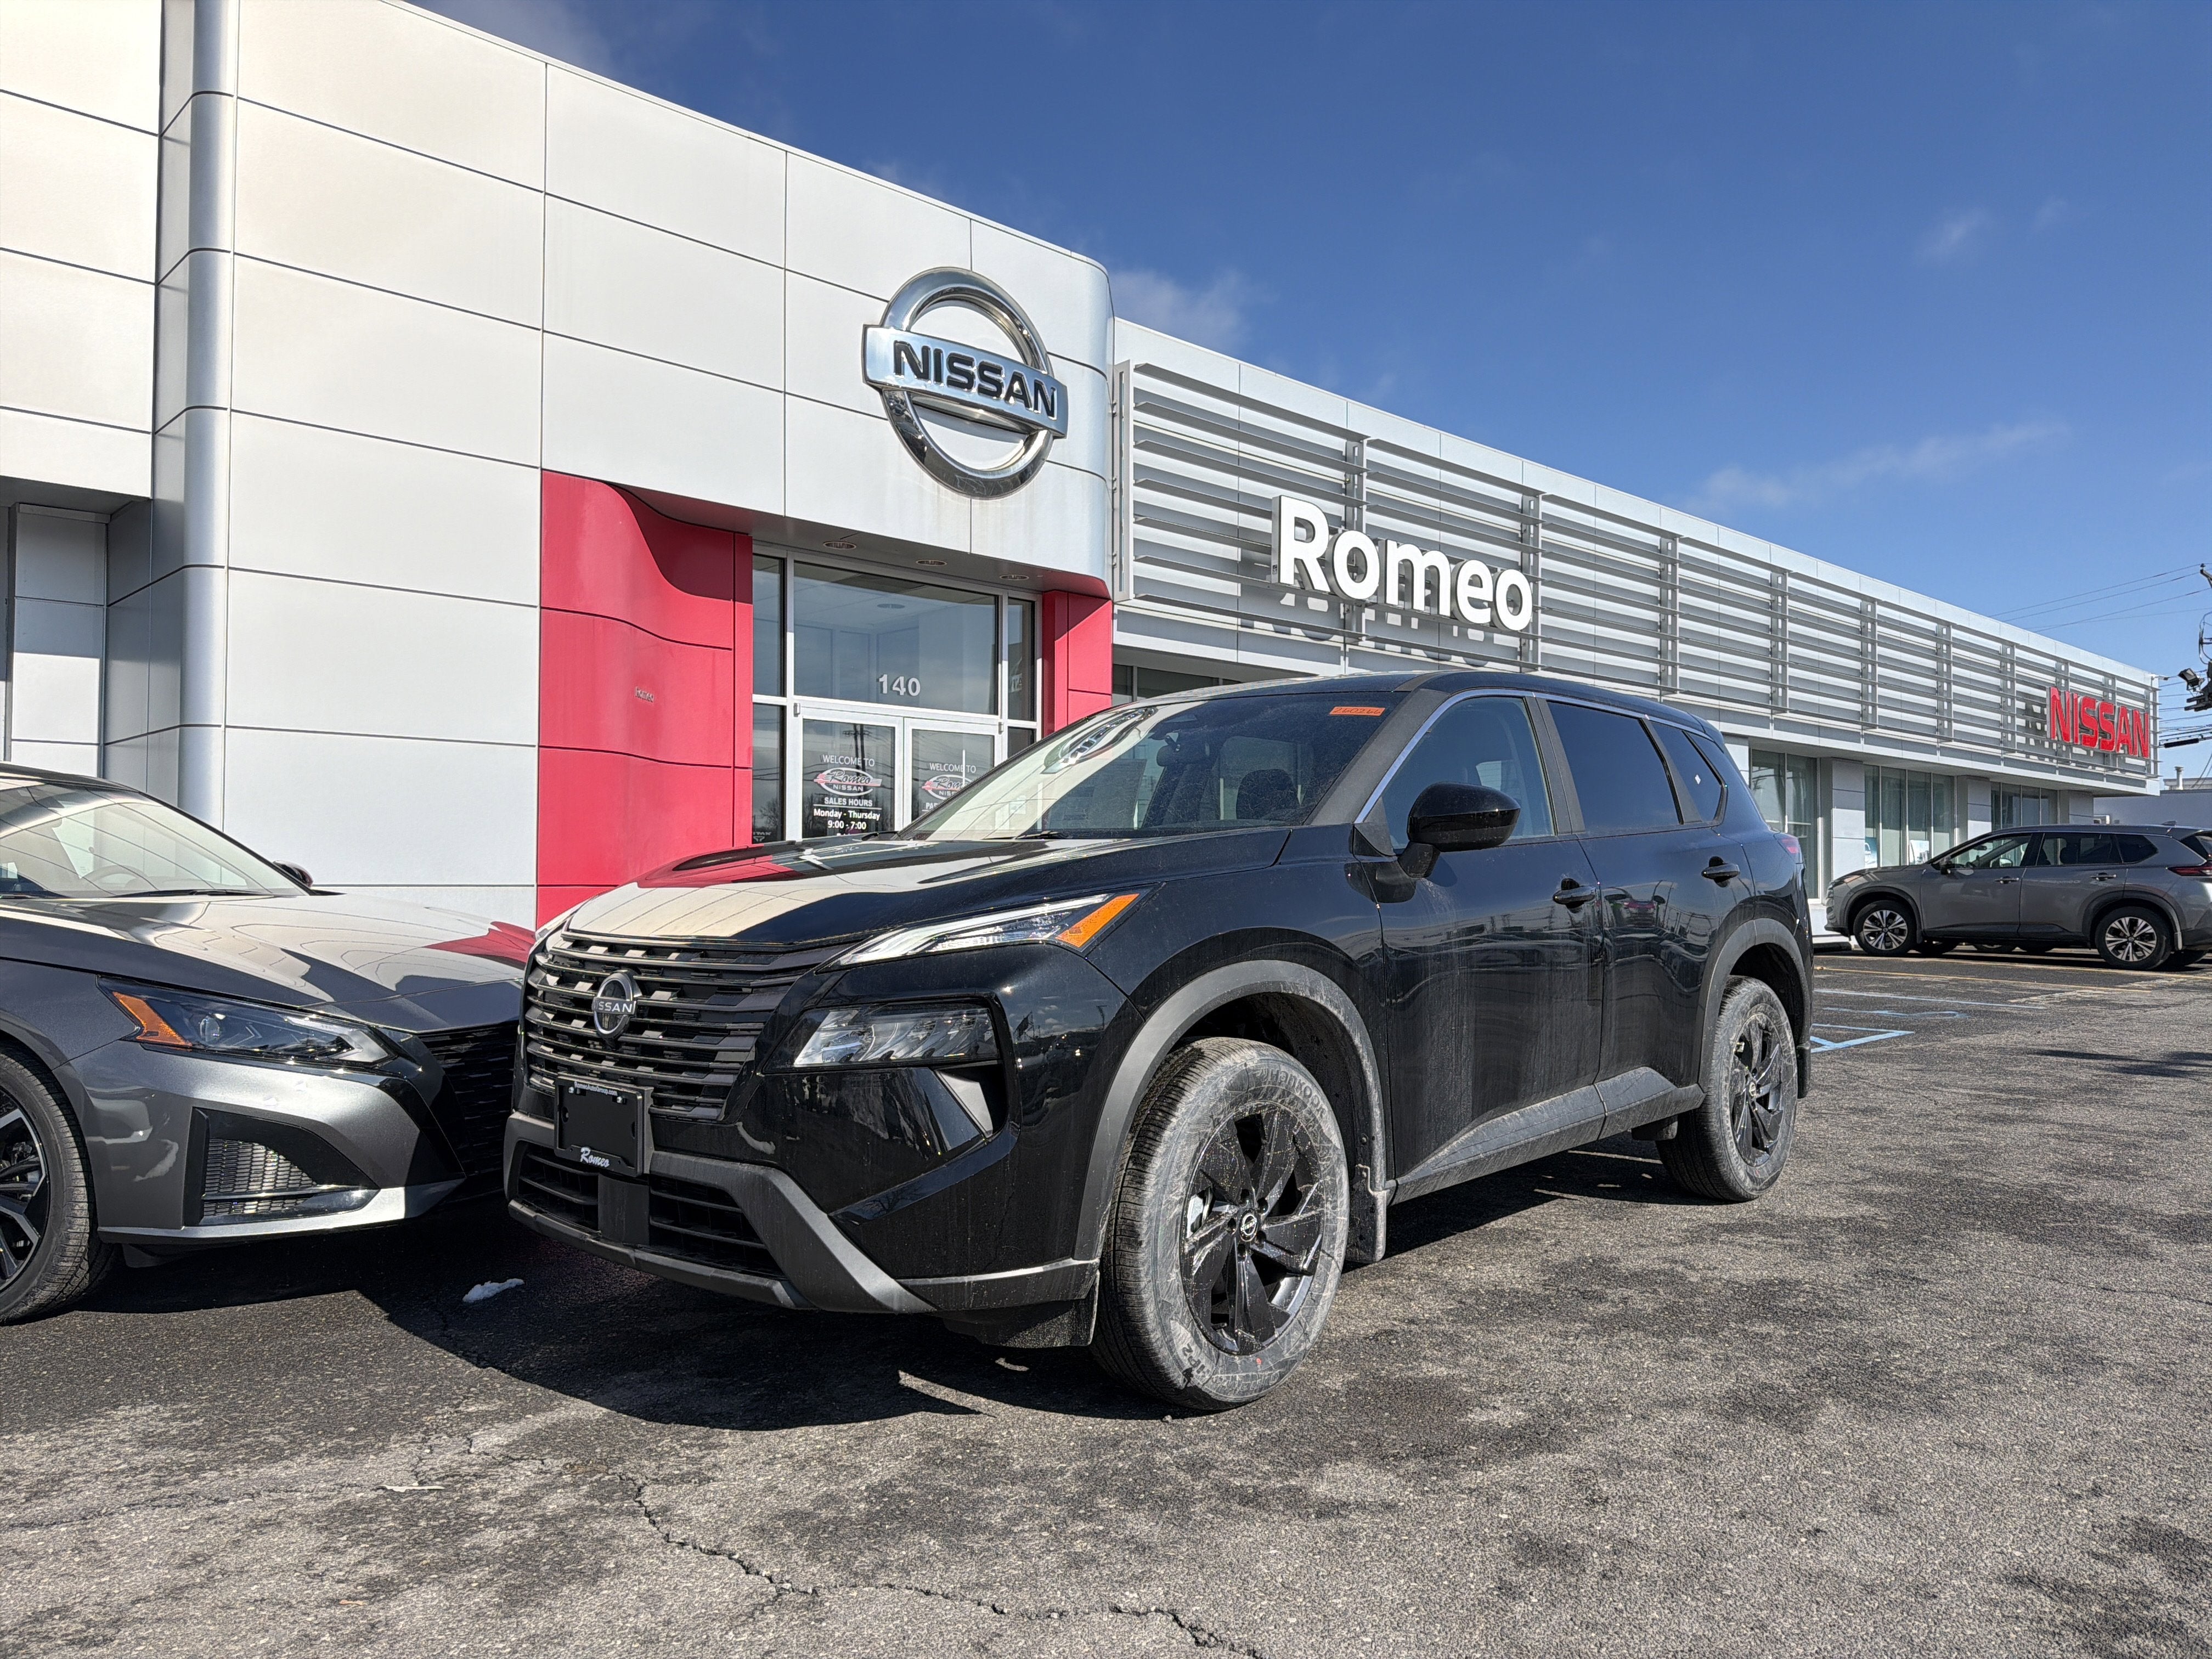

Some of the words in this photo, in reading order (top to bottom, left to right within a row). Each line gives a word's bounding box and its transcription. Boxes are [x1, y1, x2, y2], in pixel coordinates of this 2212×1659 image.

[893, 340, 1057, 421] NISSAN
[1272, 495, 1532, 631] Romeo
[878, 674, 921, 696] 140
[2048, 686, 2149, 759] NISSAN
[822, 754, 862, 766] WELCOME
[864, 758, 875, 767] TO
[929, 763, 964, 772] WELCOME
[966, 765, 977, 774] TO
[827, 769, 871, 785] Romeo
[933, 776, 963, 789] Rom
[824, 797, 847, 805] SALES
[848, 799, 873, 807] HOURS
[814, 808, 842, 819] Monday
[848, 810, 881, 821] Thursday
[827, 820, 844, 828] 9:00
[850, 821, 867, 830] 7:00
[580, 1147, 610, 1167] Romeo
